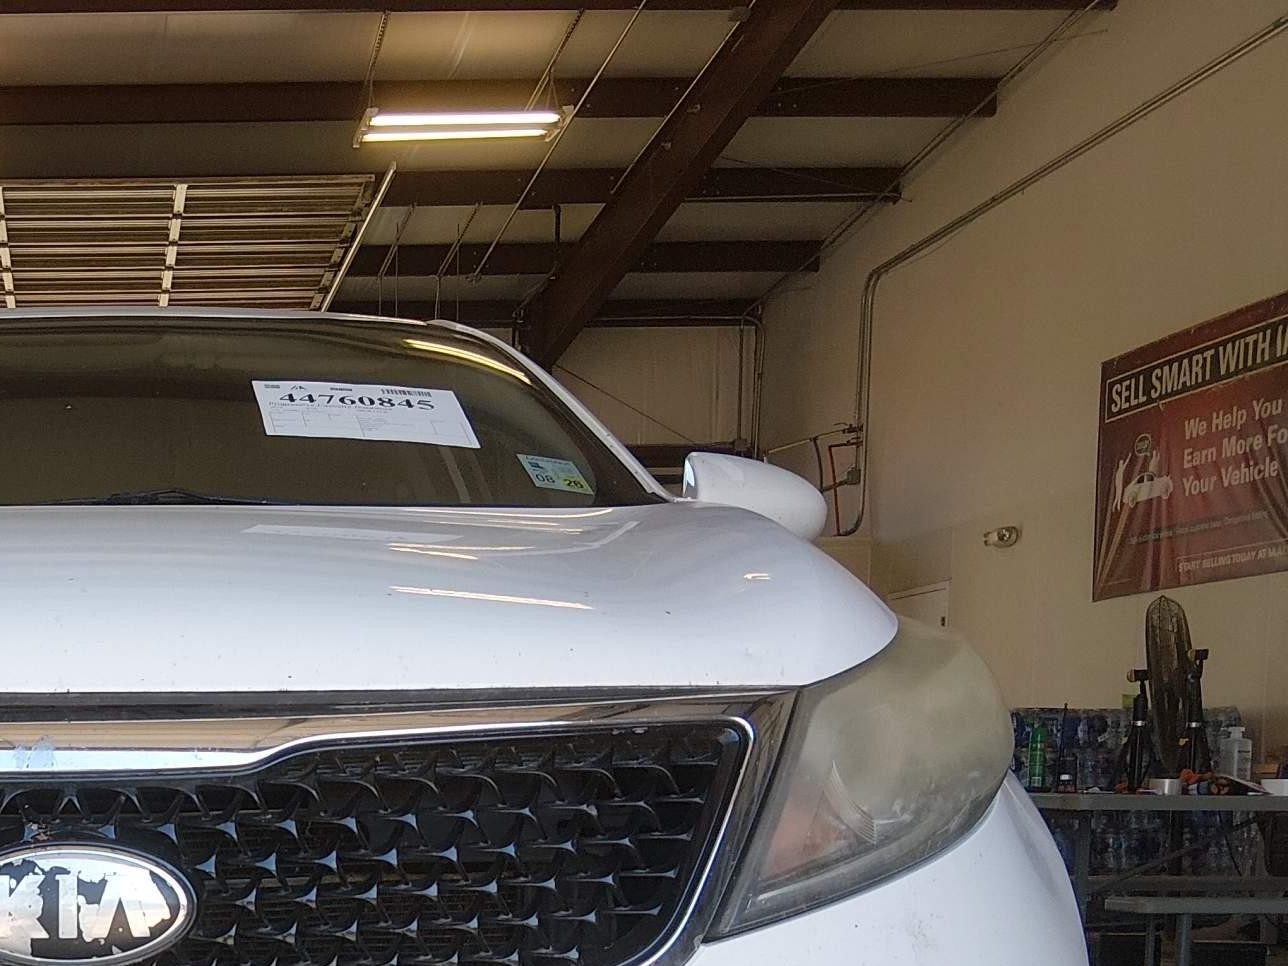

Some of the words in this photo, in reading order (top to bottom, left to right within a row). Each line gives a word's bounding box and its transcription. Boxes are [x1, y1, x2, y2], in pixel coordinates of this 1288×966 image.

[1112, 373, 1147, 412] SELL
[1151, 348, 1216, 399] SMART
[1219, 329, 1272, 376] WITH
[279, 392, 436, 411] 44760845
[1184, 418, 1208, 440] We
[1212, 406, 1247, 432] Help
[1252, 398, 1282, 420] You
[1184, 447, 1216, 468] Earn
[1222, 434, 1262, 458] More
[1182, 475, 1216, 496] Your
[1221, 457, 1278, 487] Vehicle
